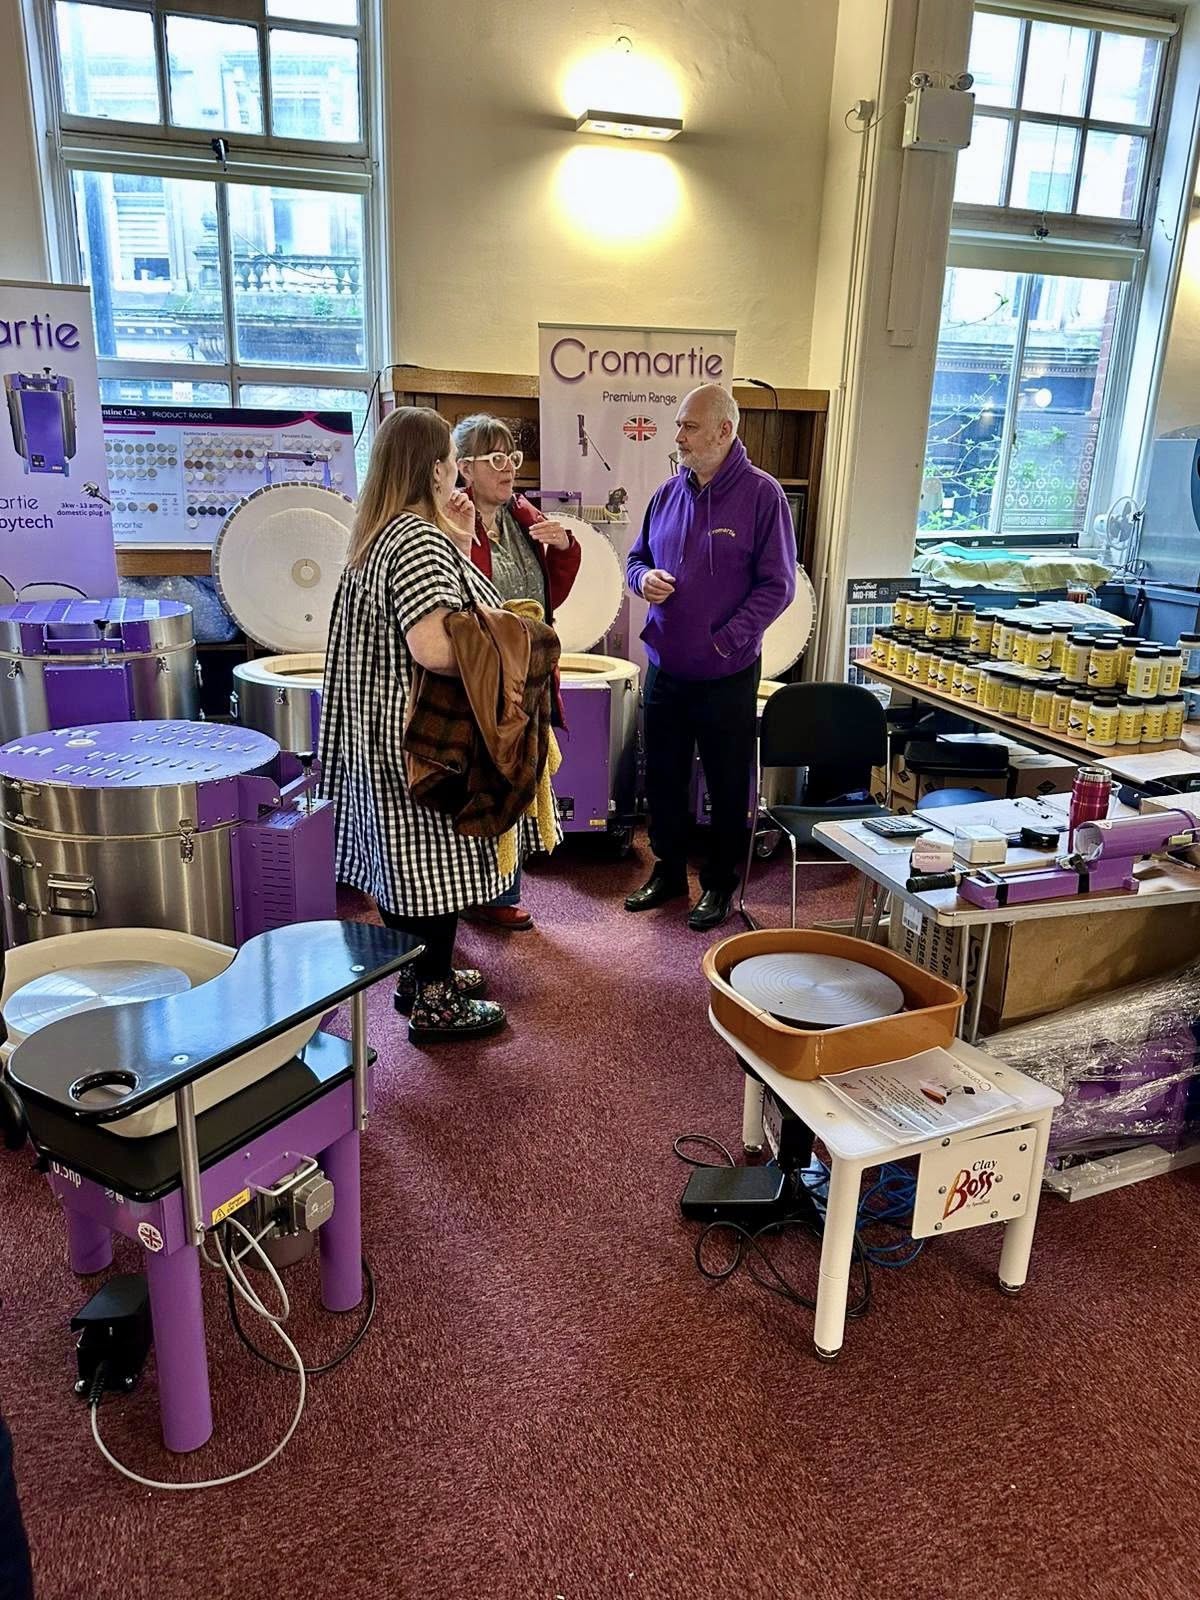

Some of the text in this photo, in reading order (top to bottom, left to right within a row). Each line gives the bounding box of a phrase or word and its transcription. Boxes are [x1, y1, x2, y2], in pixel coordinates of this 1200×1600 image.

[551, 337, 723, 382] Cromartie
[602, 391, 677, 406] Premium Range
[152, 411, 187, 419] PRODUCT
[188, 412, 213, 420] RANGE
[904, 930, 915, 956] Clay
[972, 1160, 998, 1171] Clay
